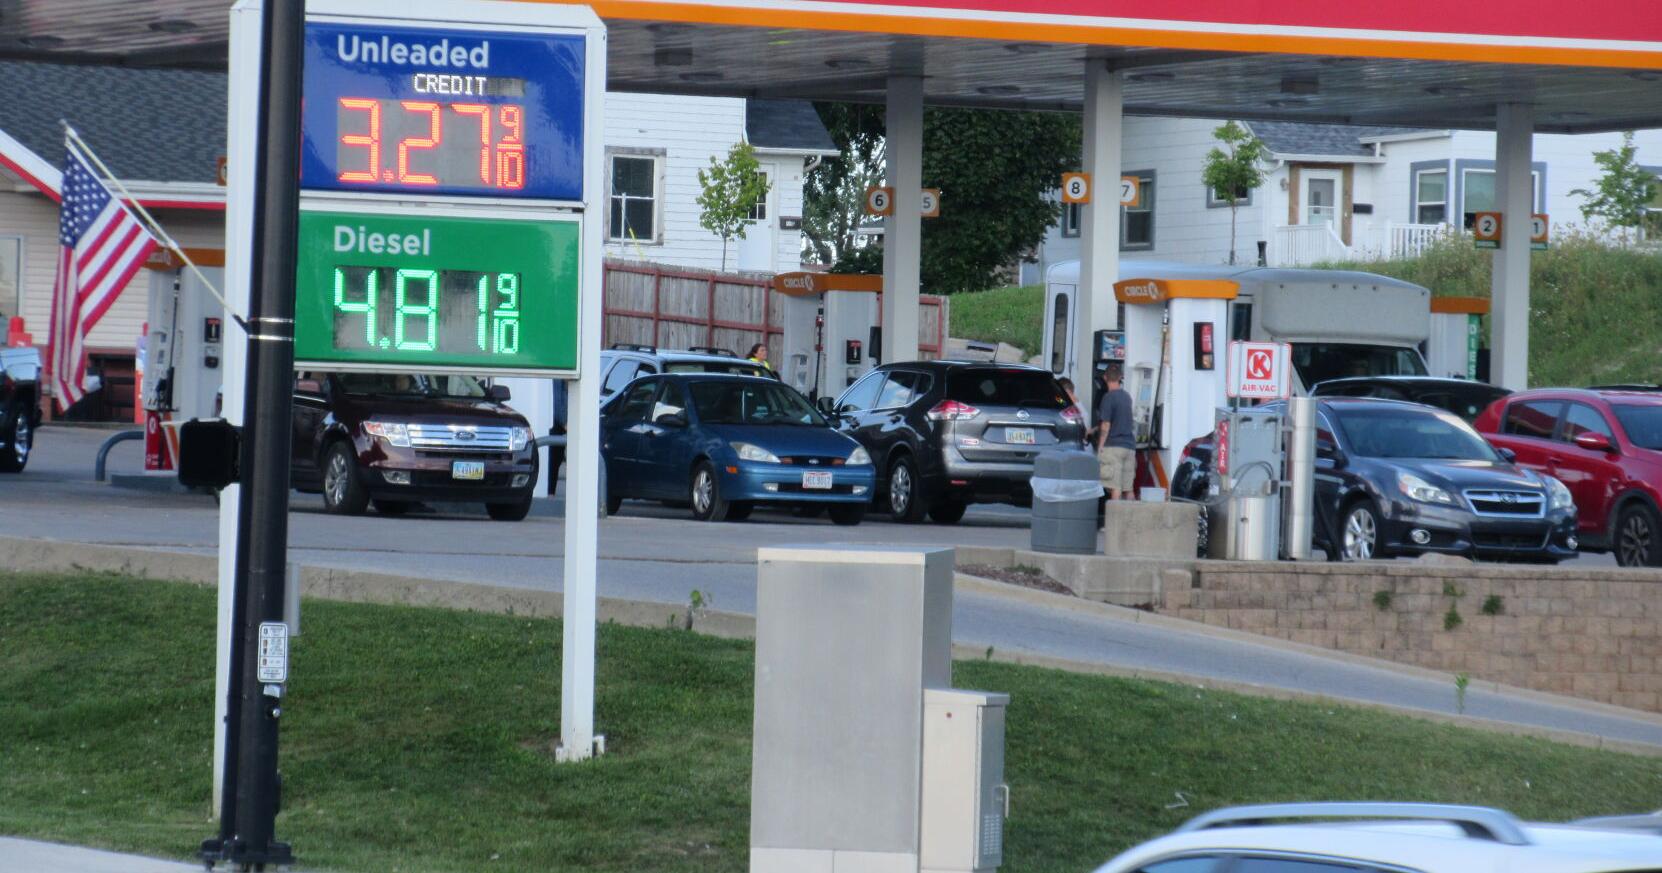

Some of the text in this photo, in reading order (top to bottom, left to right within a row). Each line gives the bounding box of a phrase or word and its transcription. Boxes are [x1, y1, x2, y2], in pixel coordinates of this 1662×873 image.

[337, 34, 489, 67] Unleaded
[414, 73, 487, 95] CREDIT
[338, 97, 490, 185] 3.27
[1071, 181, 1080, 194] 8
[1121, 184, 1130, 198] 7
[875, 194, 884, 207] 6
[922, 196, 931, 209] 5
[1483, 220, 1492, 232] 2
[334, 226, 431, 255] Diesel
[784, 277, 805, 288] CIRCLE
[1124, 285, 1149, 297] CIRCLE
[334, 267, 489, 352] 4.81
[1250, 352, 1271, 378] K
